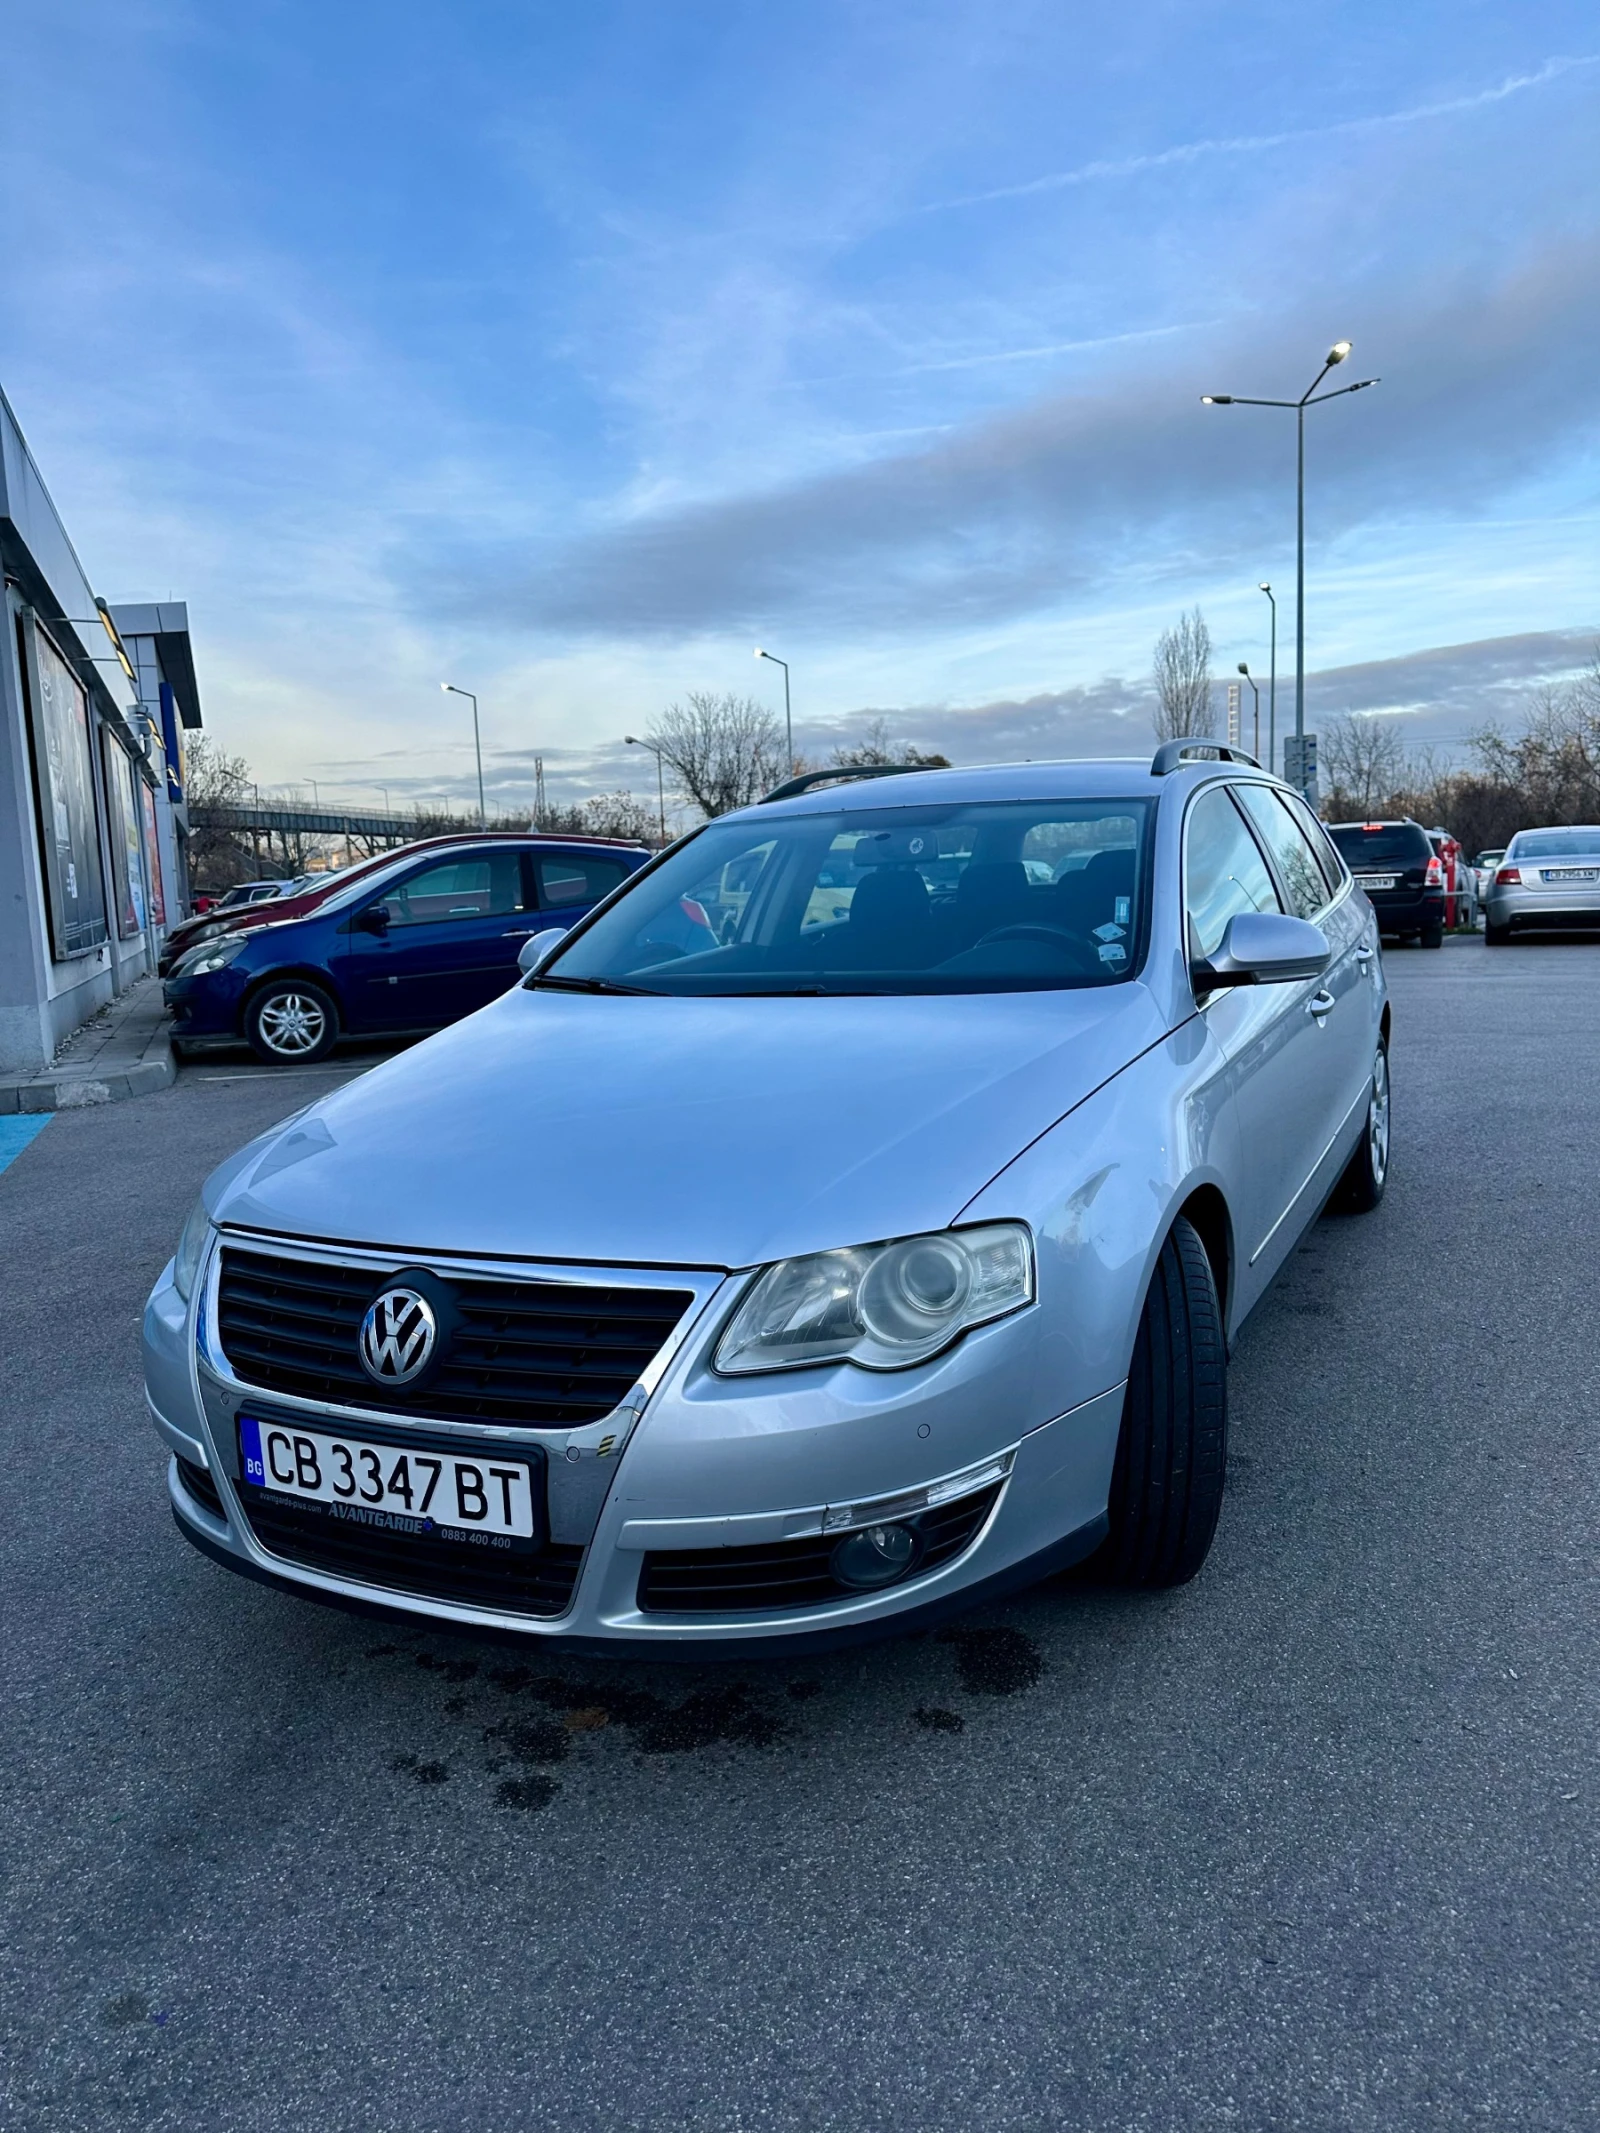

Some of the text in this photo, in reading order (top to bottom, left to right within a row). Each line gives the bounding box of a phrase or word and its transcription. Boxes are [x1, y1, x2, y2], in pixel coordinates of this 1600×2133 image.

[361, 1289, 434, 1383] VW
[247, 1458, 262, 1476] BG
[267, 1431, 520, 1526] CB 3347 BT
[328, 1503, 423, 1534] AVANTGARDE
[441, 1528, 511, 1549] 0883 400 400
